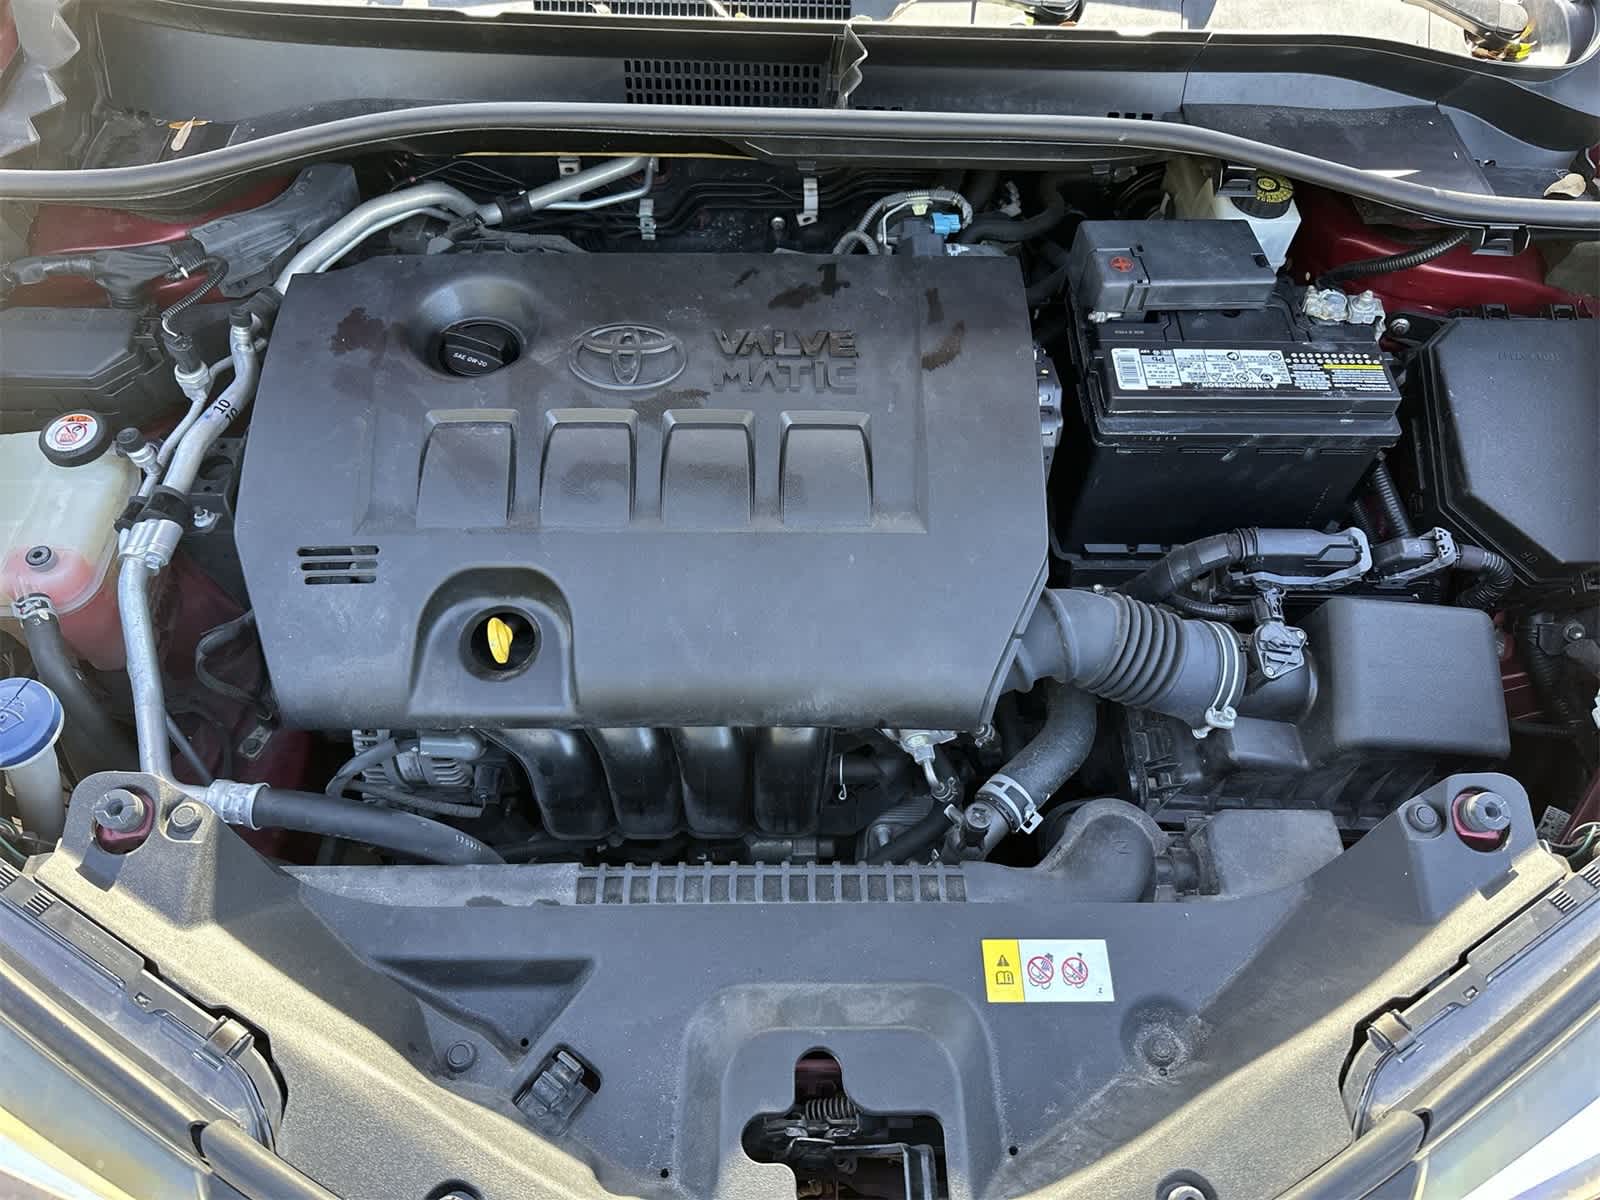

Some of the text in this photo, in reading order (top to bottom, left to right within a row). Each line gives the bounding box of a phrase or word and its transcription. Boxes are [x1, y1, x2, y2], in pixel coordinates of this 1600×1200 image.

[712, 328, 859, 358] VALVE
[453, 352, 467, 361] SAE
[711, 358, 857, 394] MATIC
[213, 399, 231, 414] 10
